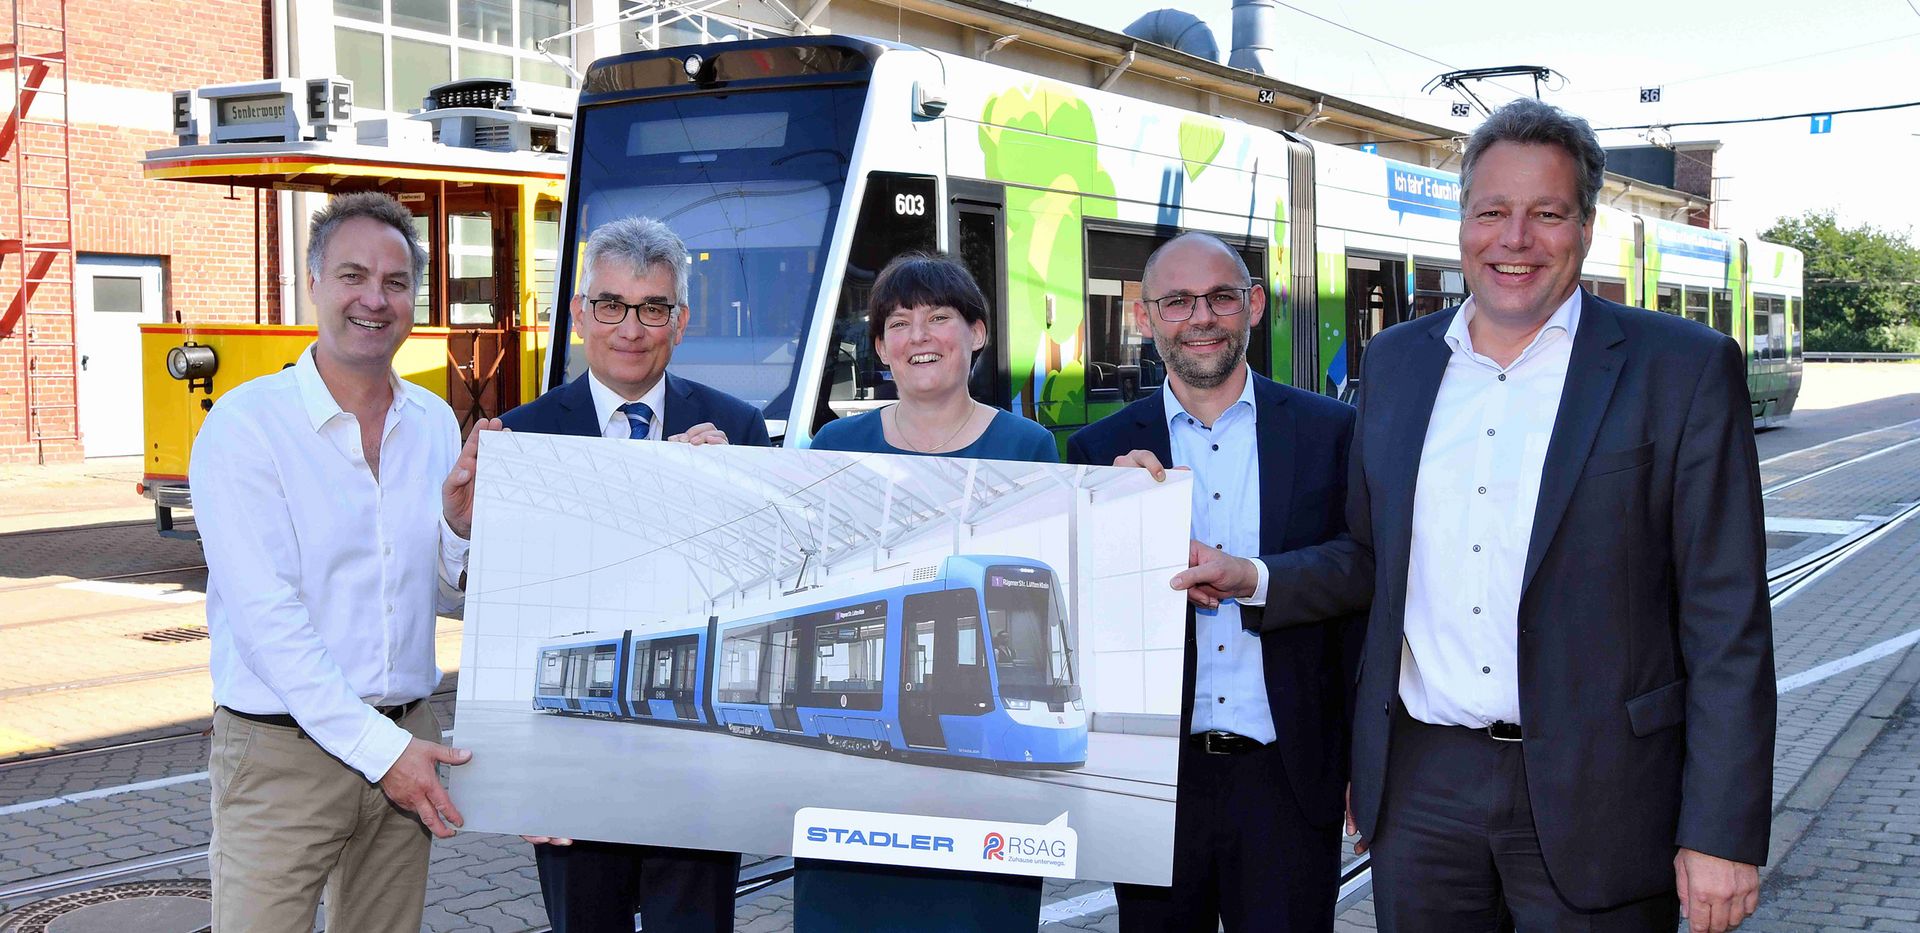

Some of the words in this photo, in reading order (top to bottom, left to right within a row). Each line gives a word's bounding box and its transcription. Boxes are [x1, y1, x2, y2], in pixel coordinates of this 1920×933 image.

[1259, 90, 1275, 104] 34
[1641, 89, 1660, 102] 36
[175, 97, 188, 128] E
[1452, 103, 1470, 117] 35
[1815, 116, 1829, 133] T
[1394, 172, 1407, 192] Ich
[1425, 177, 1432, 198] E
[1431, 180, 1452, 201] durch
[895, 193, 925, 216] 603
[806, 826, 954, 853] STADLER
[1008, 836, 1066, 858] RSAG
[1008, 855, 1033, 864] Zuhause
[1034, 858, 1066, 867] unterwegs.
